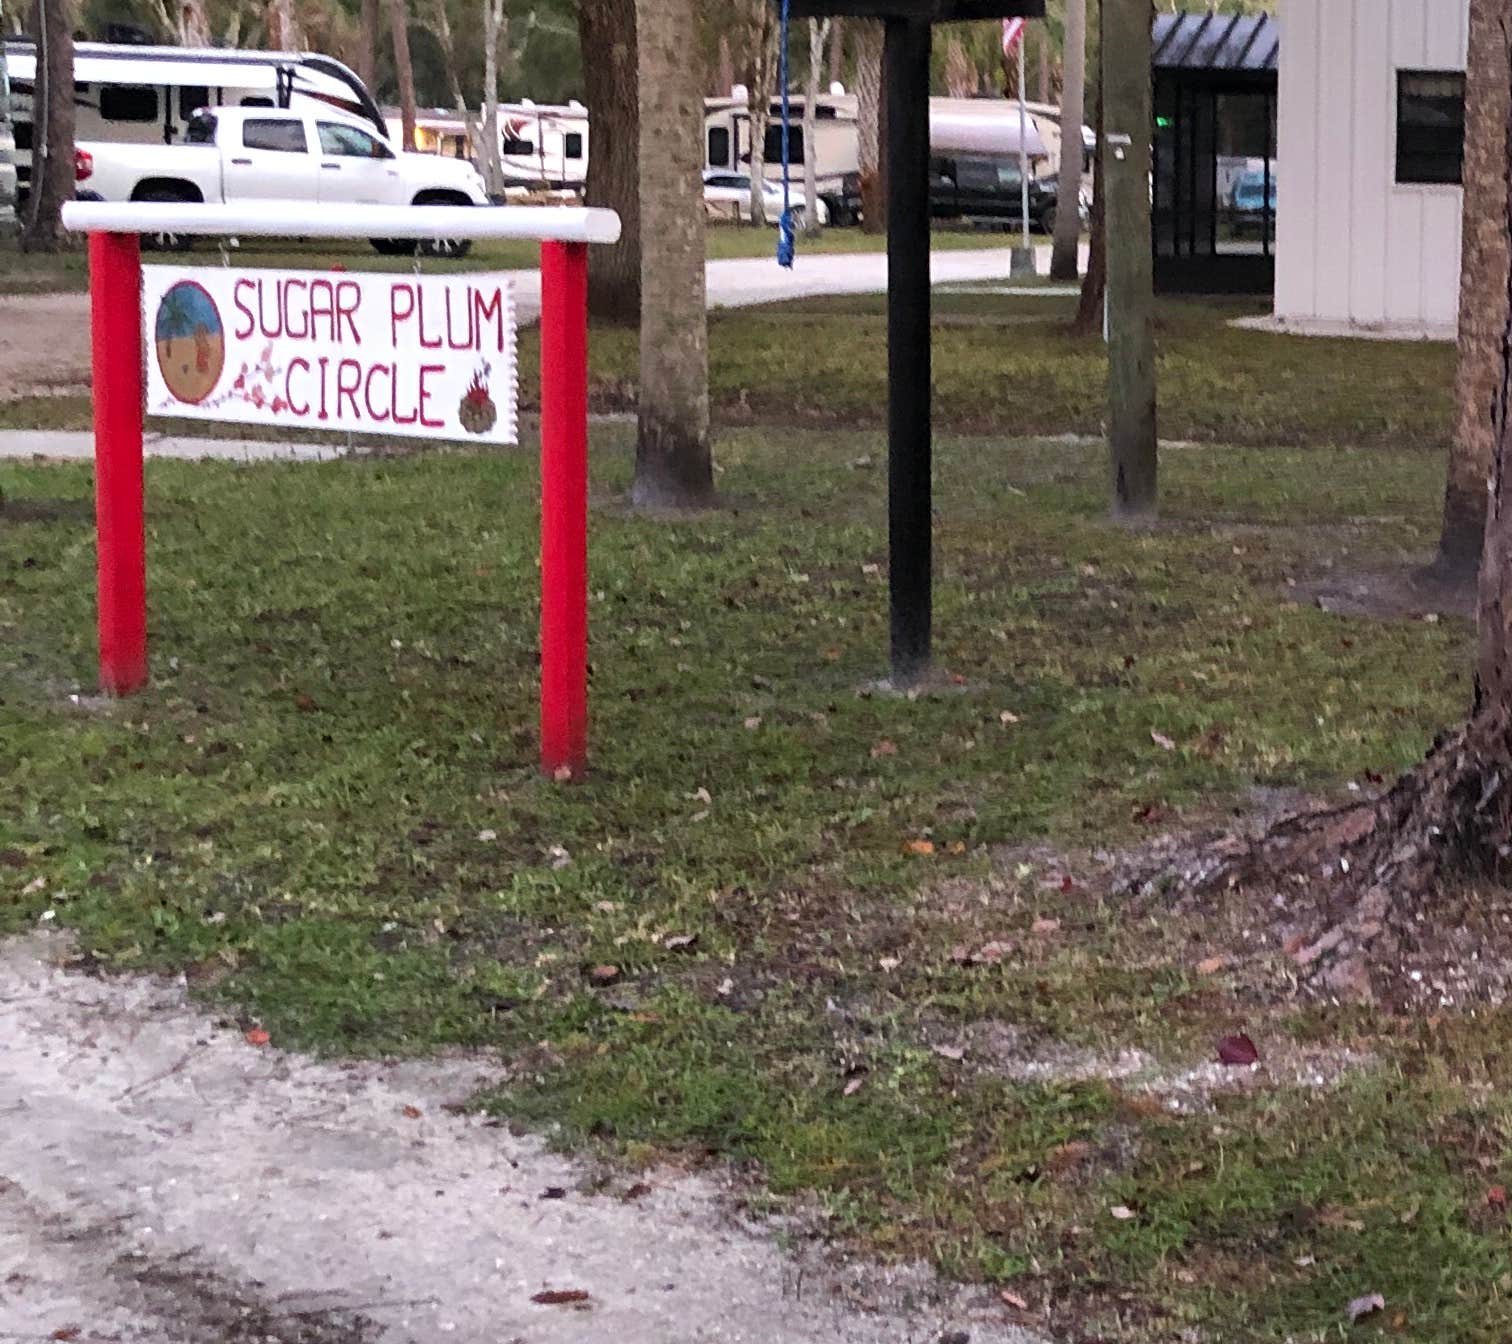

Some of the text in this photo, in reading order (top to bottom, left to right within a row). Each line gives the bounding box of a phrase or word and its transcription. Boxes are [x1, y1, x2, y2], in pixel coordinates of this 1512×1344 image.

[233, 278, 503, 353] SUGAR PLUM
[285, 358, 447, 427] CIRCLE
